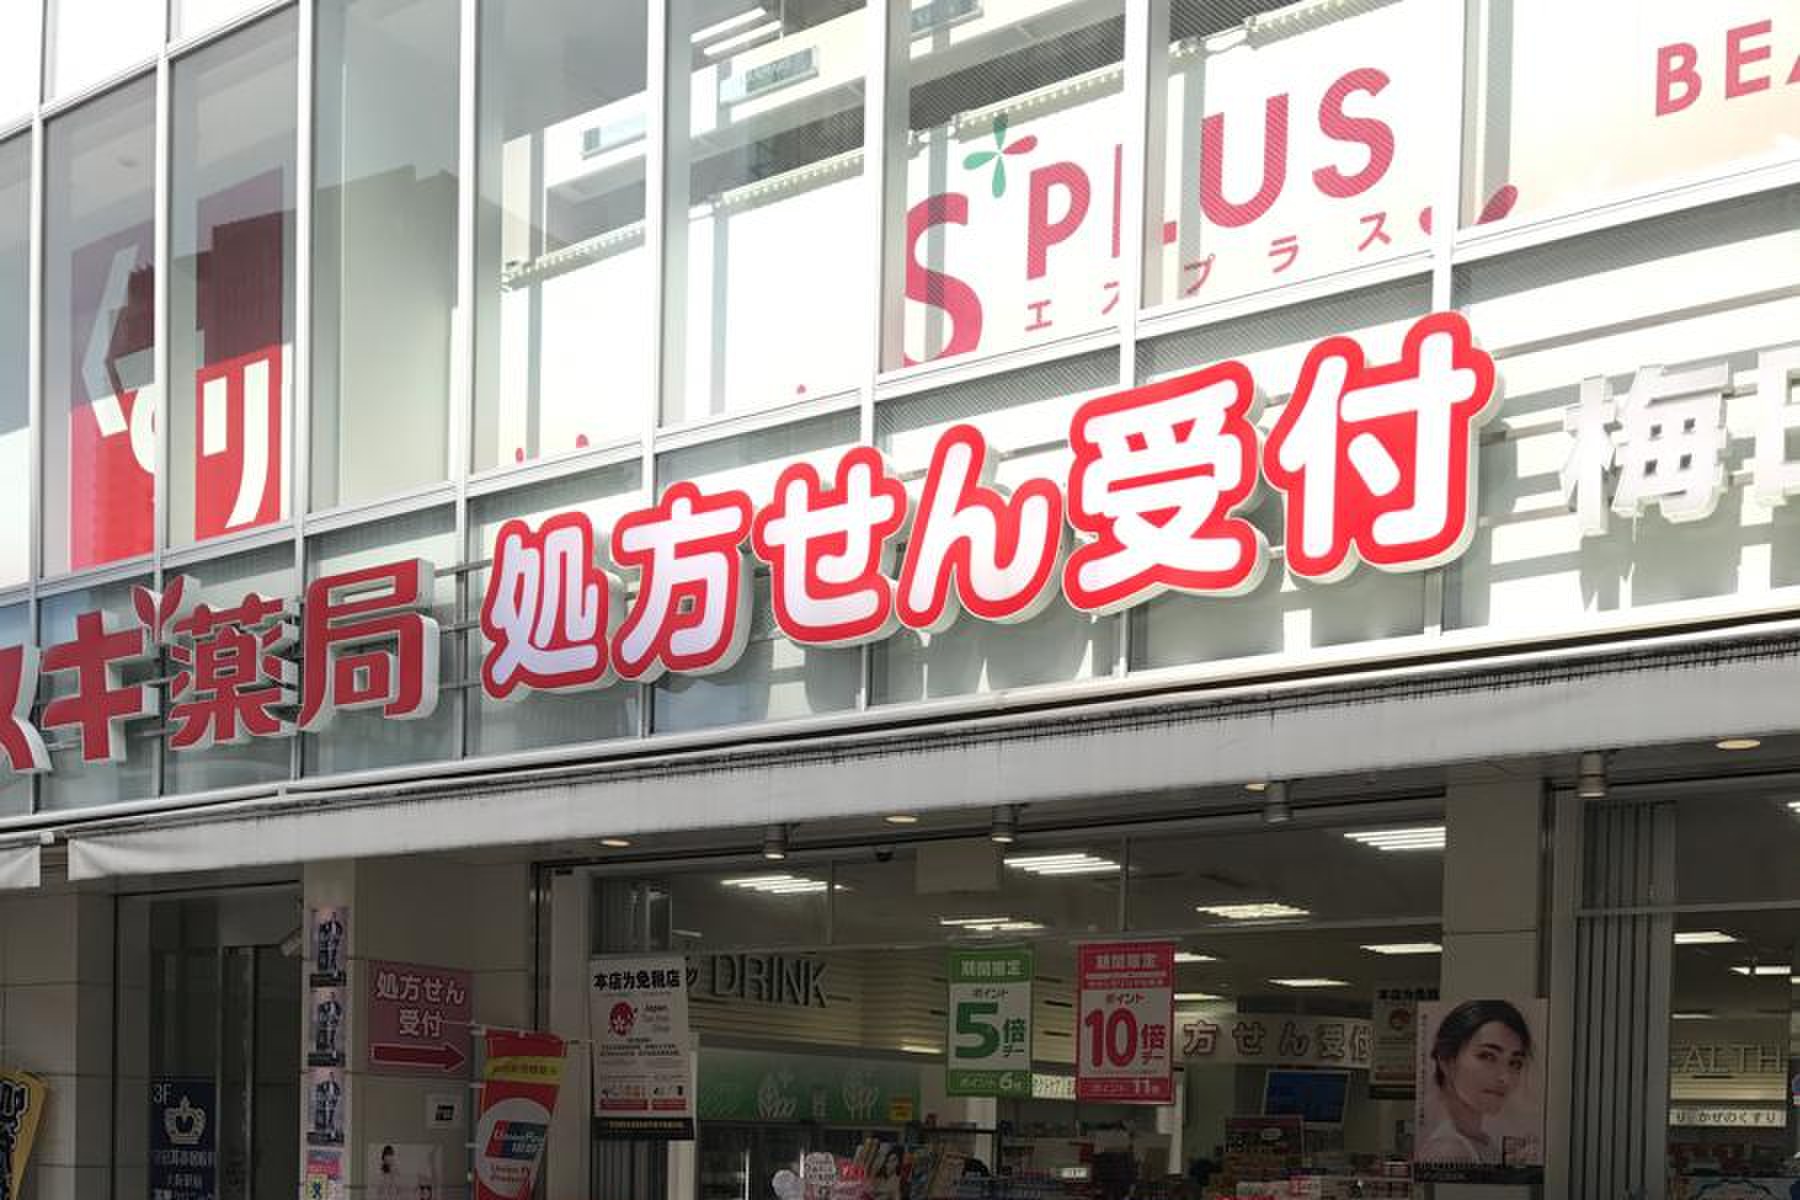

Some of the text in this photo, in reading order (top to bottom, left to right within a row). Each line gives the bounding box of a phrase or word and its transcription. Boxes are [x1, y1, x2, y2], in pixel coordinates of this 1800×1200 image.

[480, 311, 1500, 702] 処方せん受付
[376, 972, 465, 1004] 処方せん
[711, 954, 828, 1008] DRINK
[399, 1009, 445, 1037] 受付
[1184, 1019, 1375, 1061] 方せん受付
